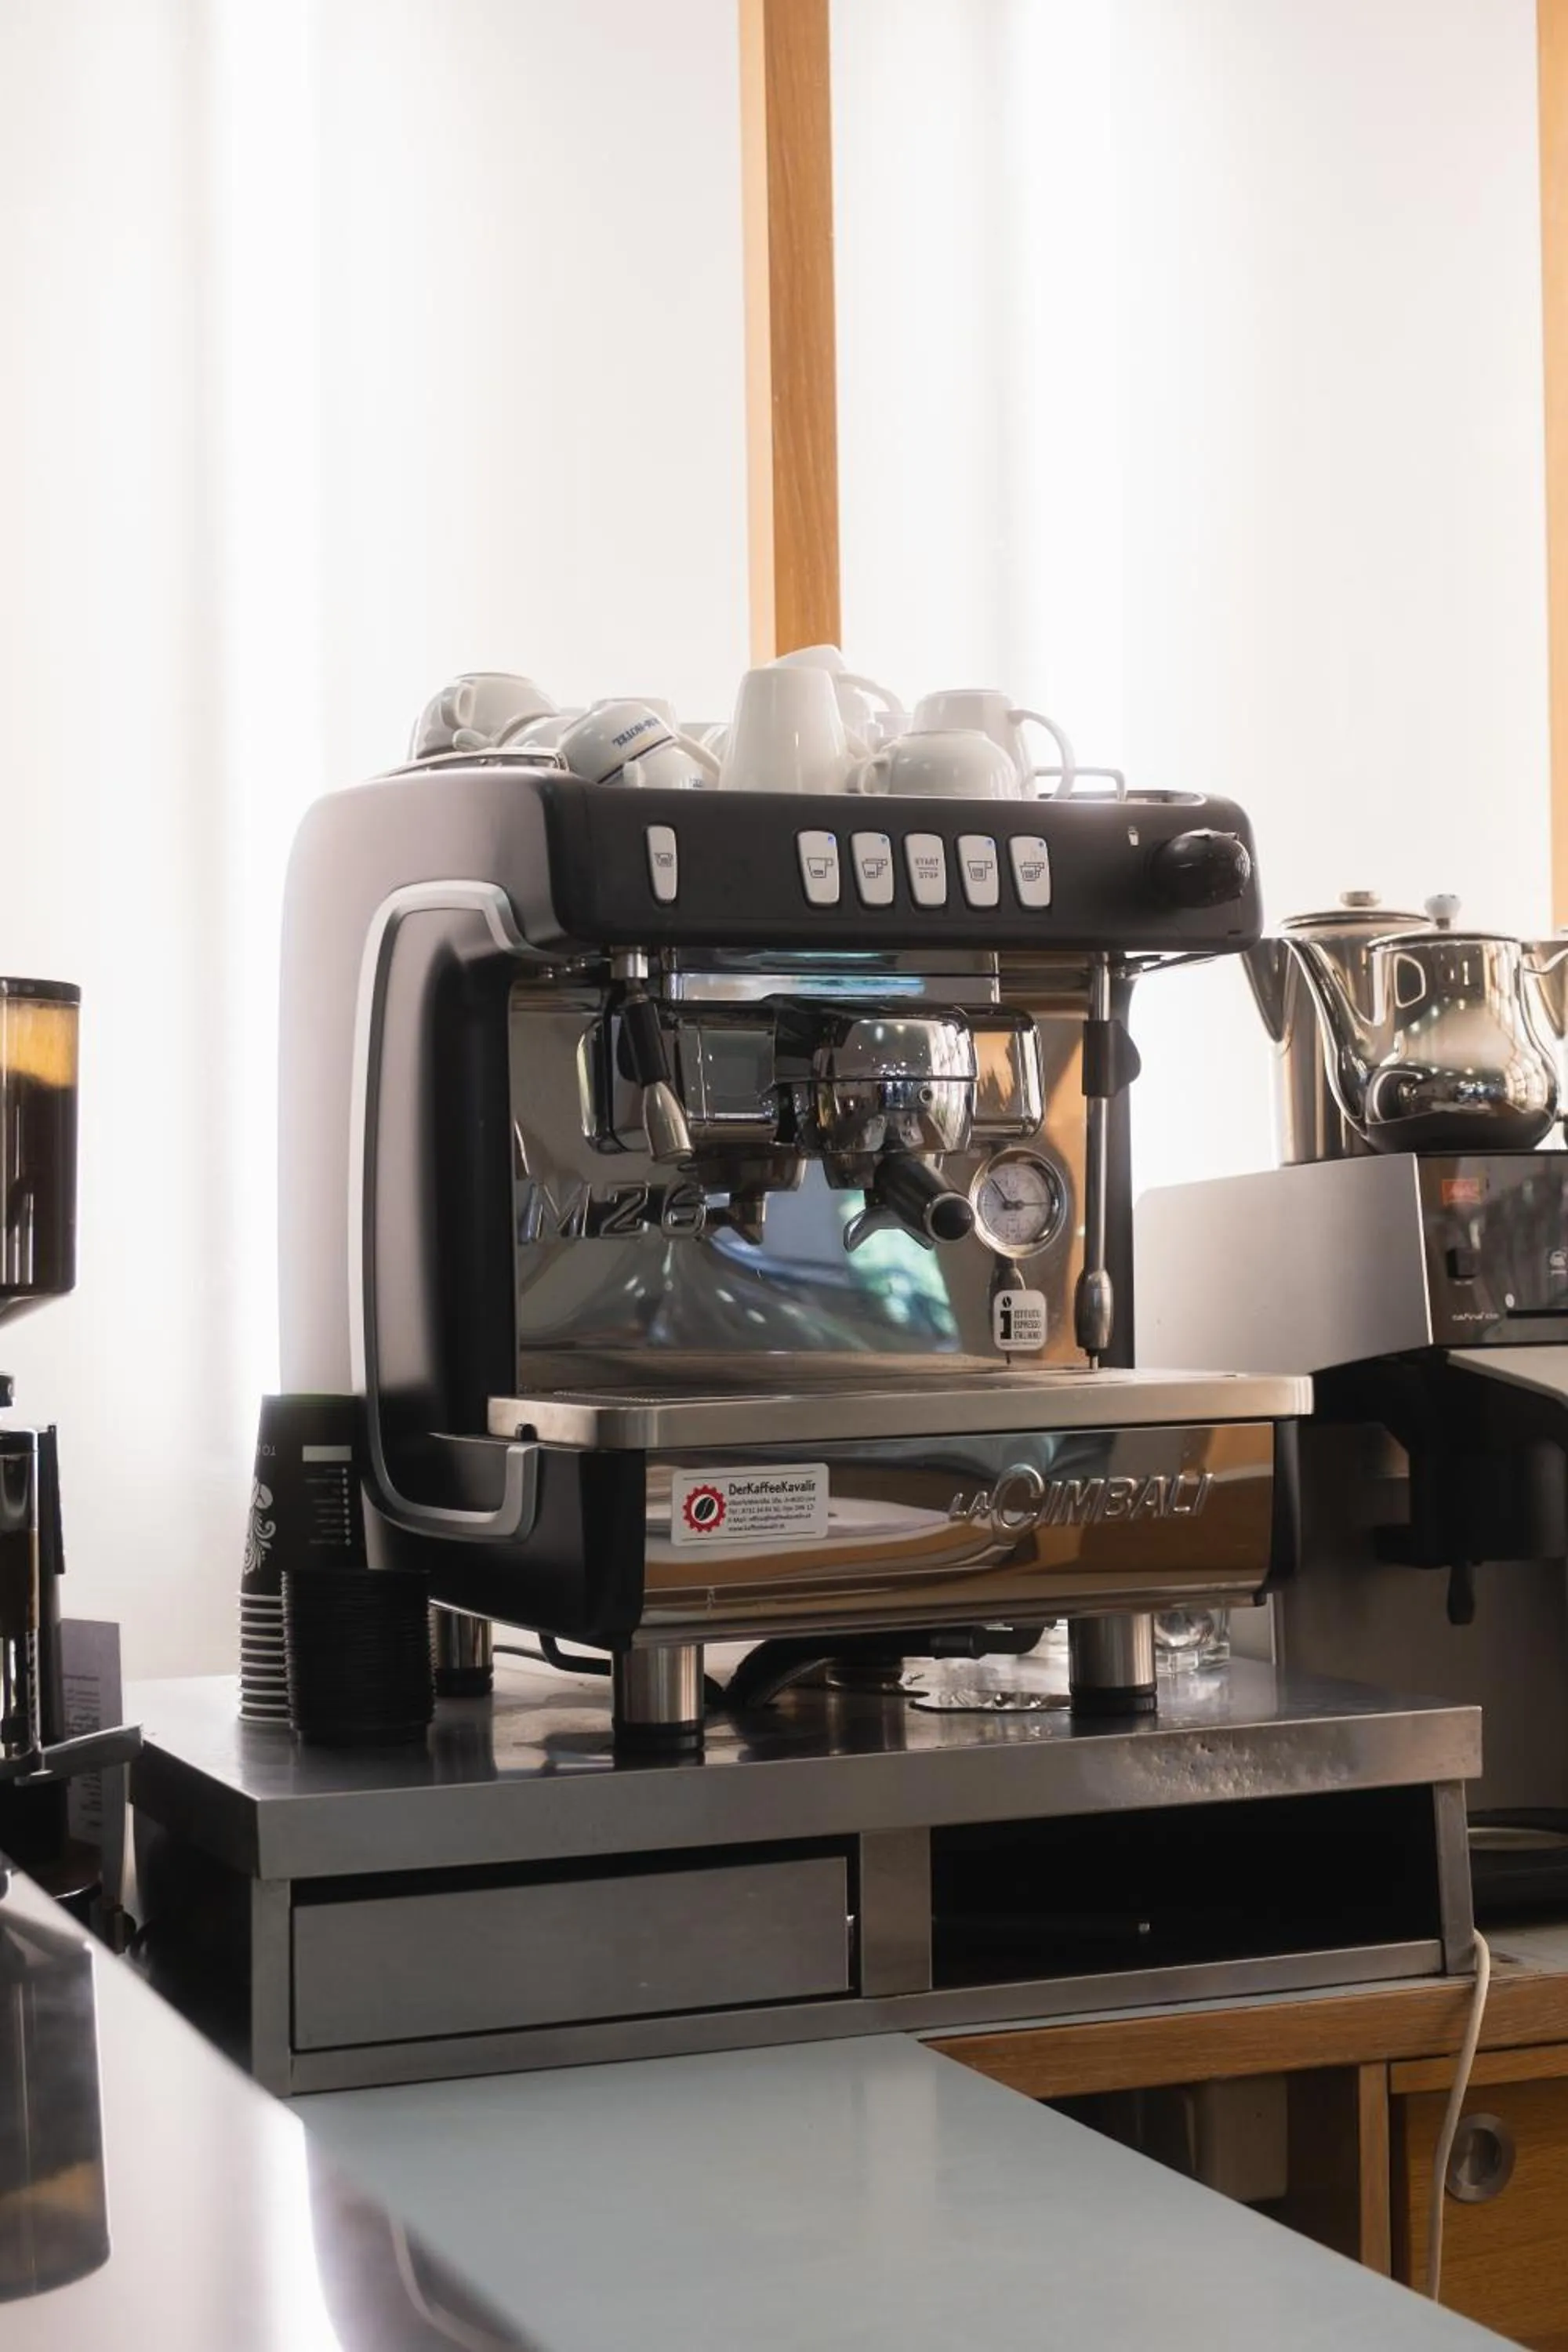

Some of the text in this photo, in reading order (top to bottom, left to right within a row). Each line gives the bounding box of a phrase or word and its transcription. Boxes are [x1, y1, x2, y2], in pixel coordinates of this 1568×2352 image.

[915, 858, 939, 866] START
[948, 1463, 1215, 1530] LA CIMBALI
